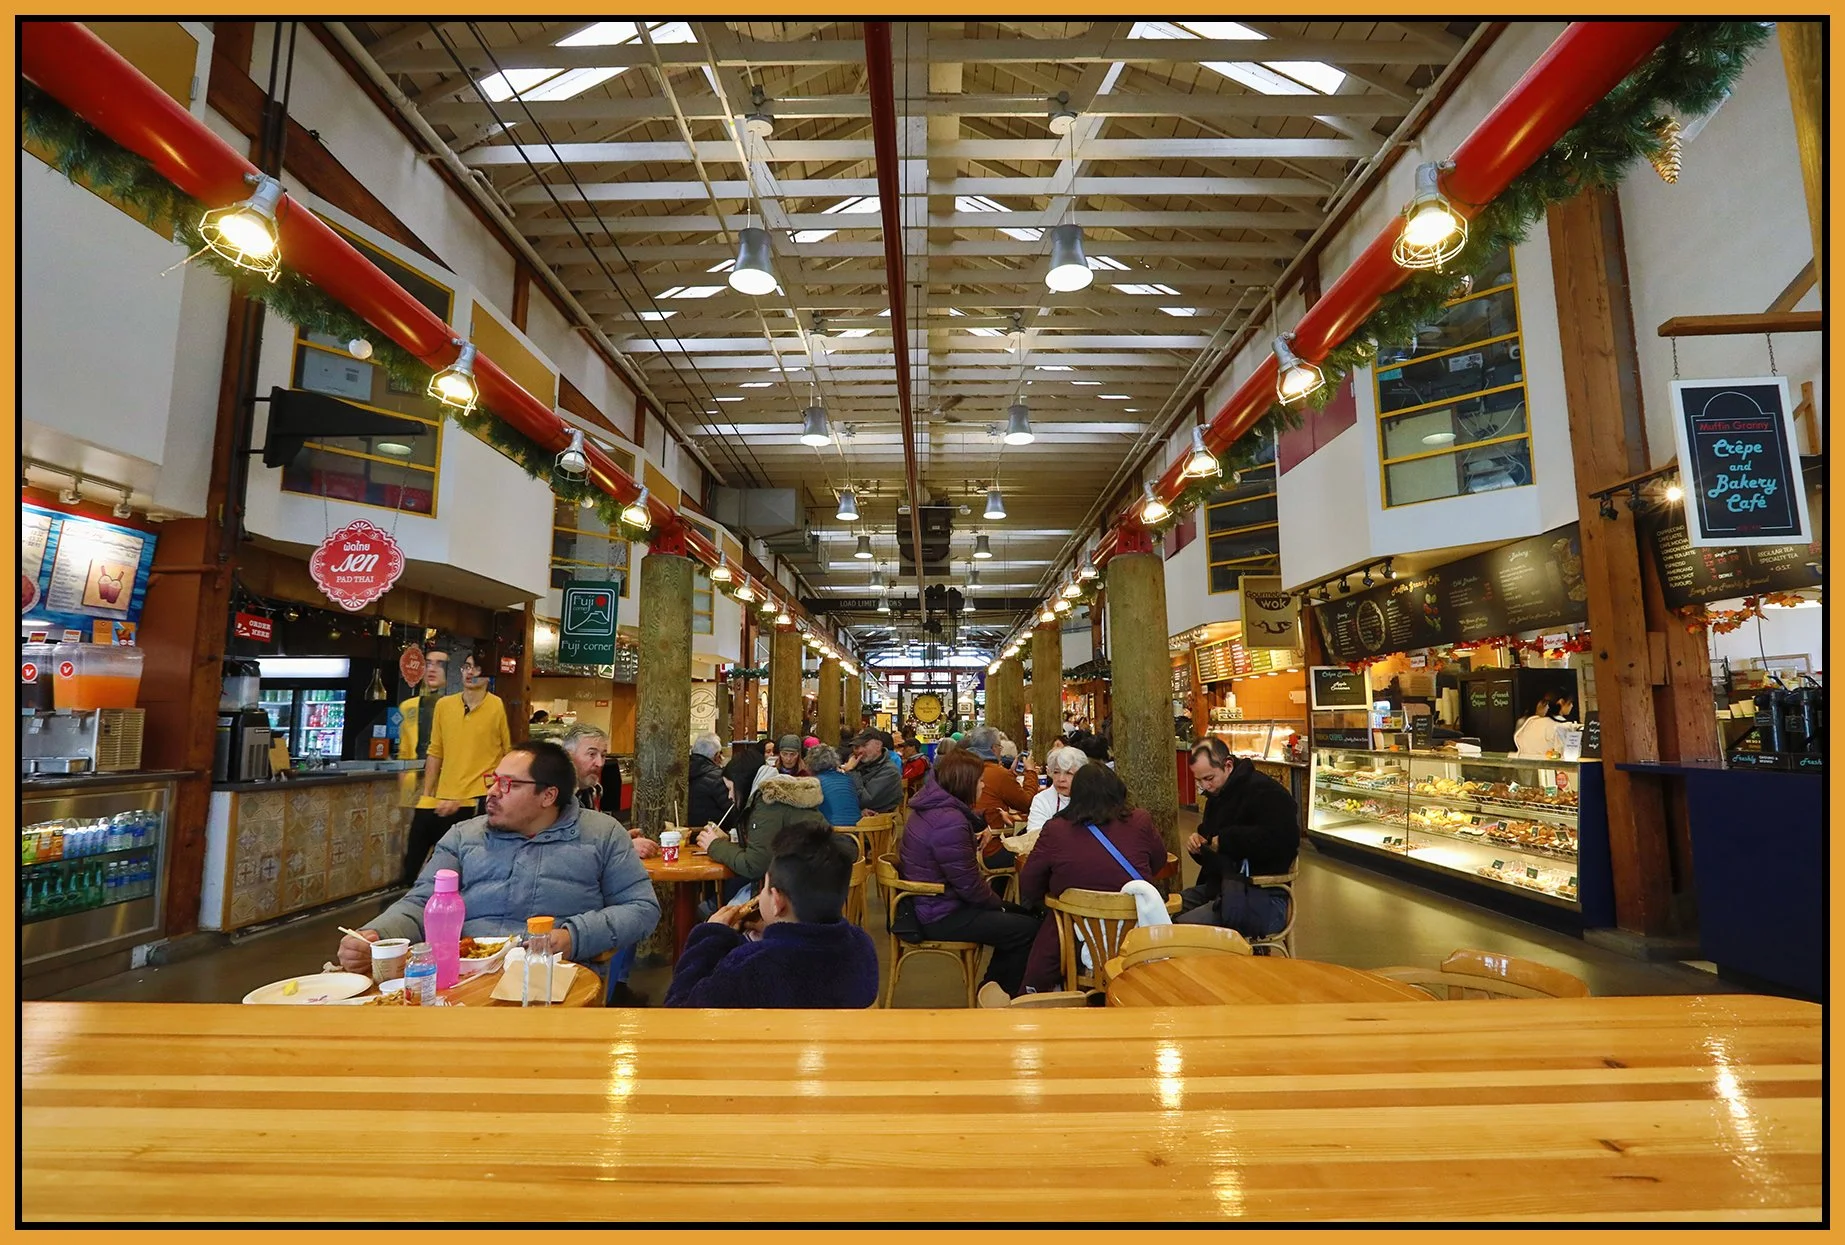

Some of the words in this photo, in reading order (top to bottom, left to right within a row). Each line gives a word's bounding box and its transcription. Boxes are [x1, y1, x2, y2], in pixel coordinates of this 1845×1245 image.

[1700, 422, 1730, 431] Muffin
[1732, 420, 1769, 430] Granny
[1712, 439, 1763, 461] Crêpe
[1729, 460, 1752, 472] and
[1707, 473, 1778, 498] Bakery
[1726, 493, 1768, 513] Café
[330, 553, 379, 573] sen
[336, 575, 353, 583] PAD
[354, 575, 374, 583] THAI
[573, 595, 594, 614] Fuji
[249, 620, 271, 630] ORDER
[561, 640, 580, 657] Fuji
[583, 643, 613, 651] corner
[1732, 754, 1757, 765] Freshly
